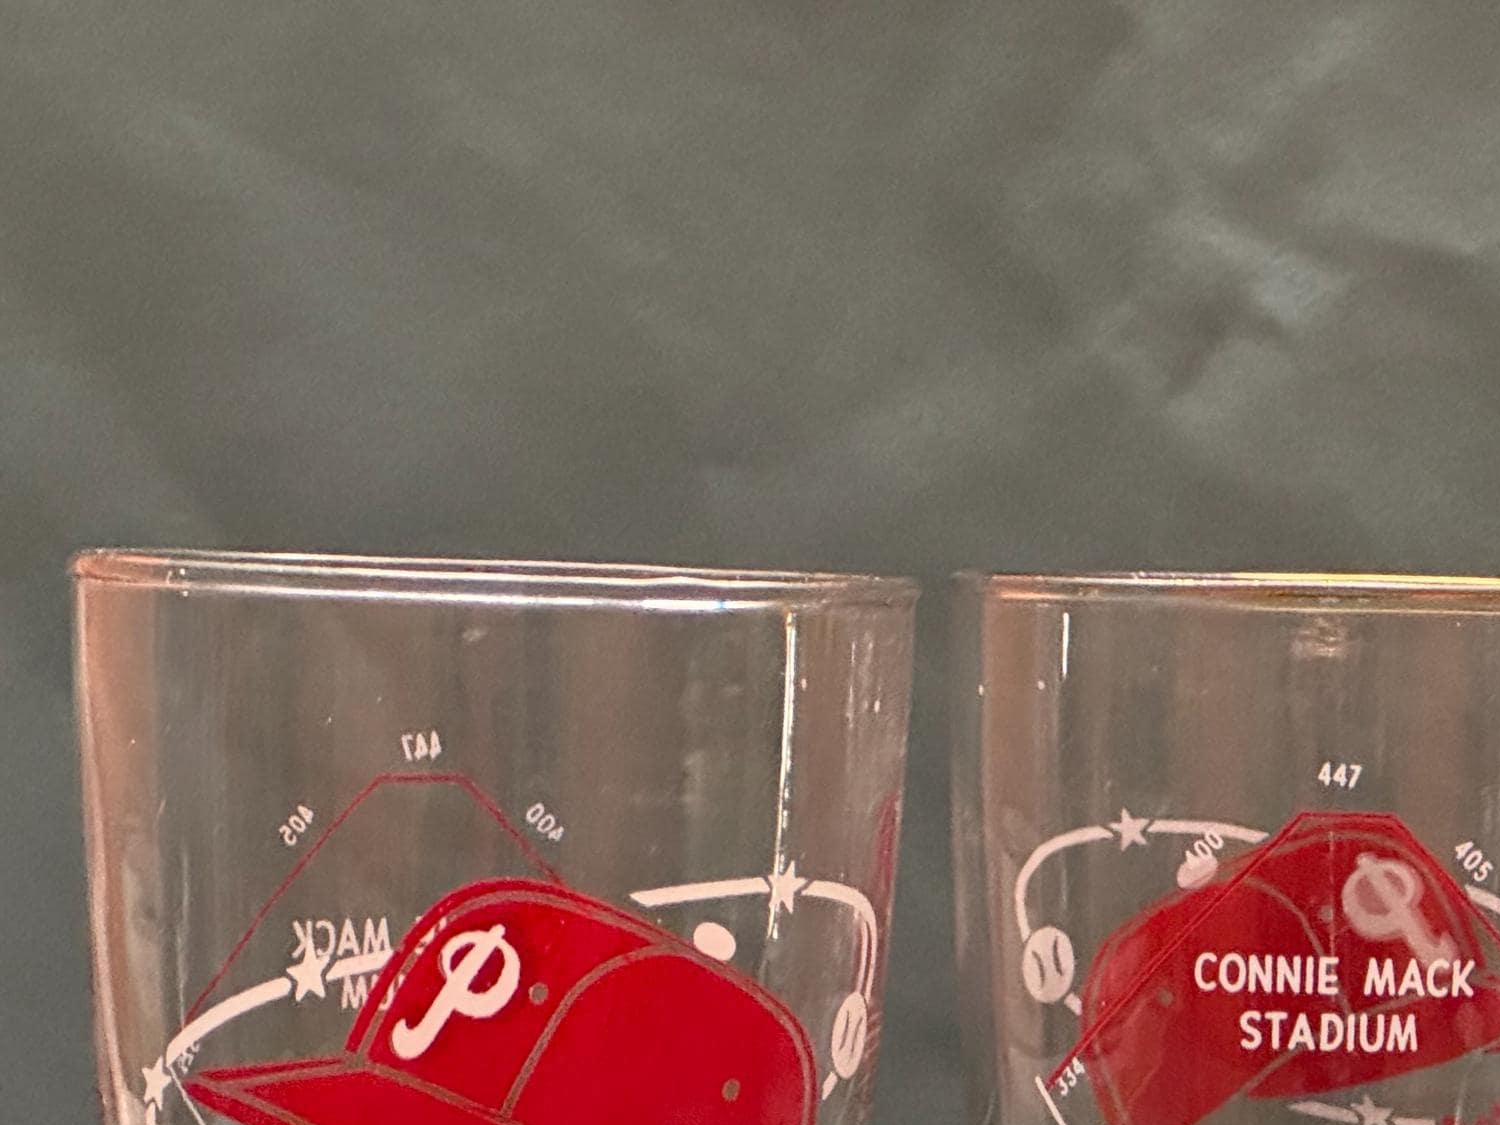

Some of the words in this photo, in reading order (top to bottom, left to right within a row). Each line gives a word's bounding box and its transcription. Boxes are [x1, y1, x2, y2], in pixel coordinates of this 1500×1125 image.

[1317, 761, 1363, 789] 447
[1454, 840, 1495, 883] 405
[391, 923, 521, 1061] P
[1194, 952, 1340, 997] CONNIE
[1363, 956, 1476, 999] MACK
[1238, 1010, 1418, 1053] STADIUM
[1053, 1055, 1086, 1097] 334
